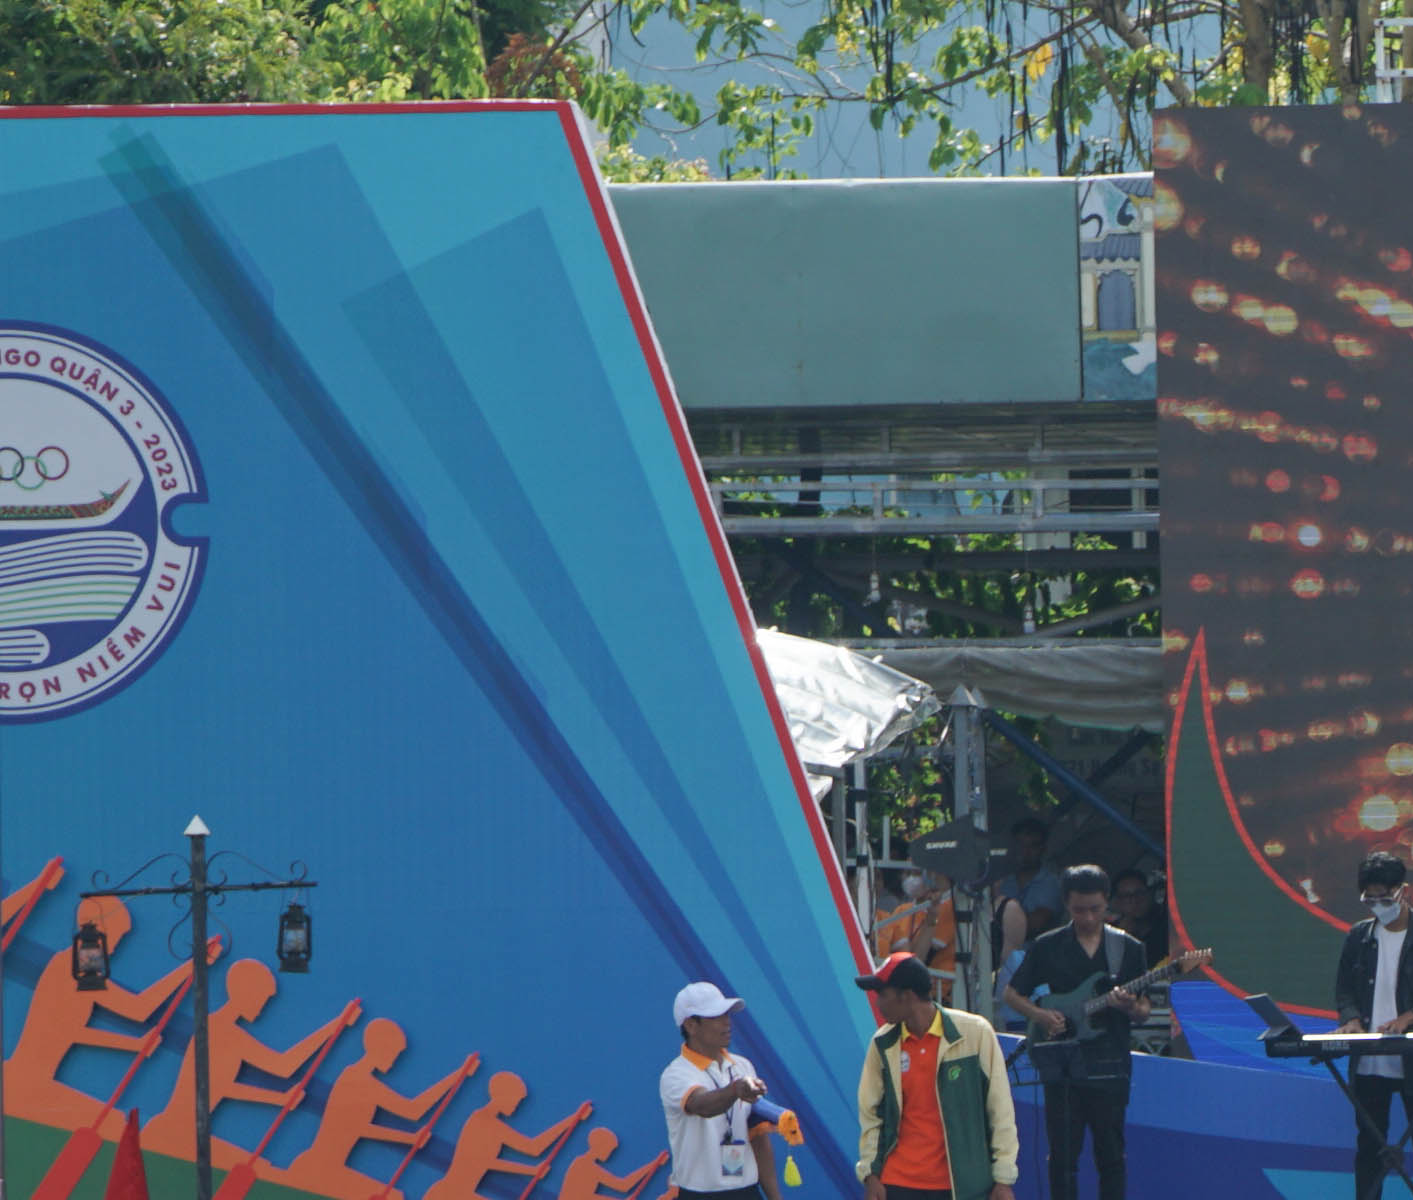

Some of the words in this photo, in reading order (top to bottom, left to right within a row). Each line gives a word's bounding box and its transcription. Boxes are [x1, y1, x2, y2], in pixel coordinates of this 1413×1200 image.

[0, 348, 41, 367] GO
[49, 355, 119, 402] QUẬN
[120, 400, 135, 417] 3
[144, 435, 178, 491] 2023
[147, 561, 181, 614] VUI
